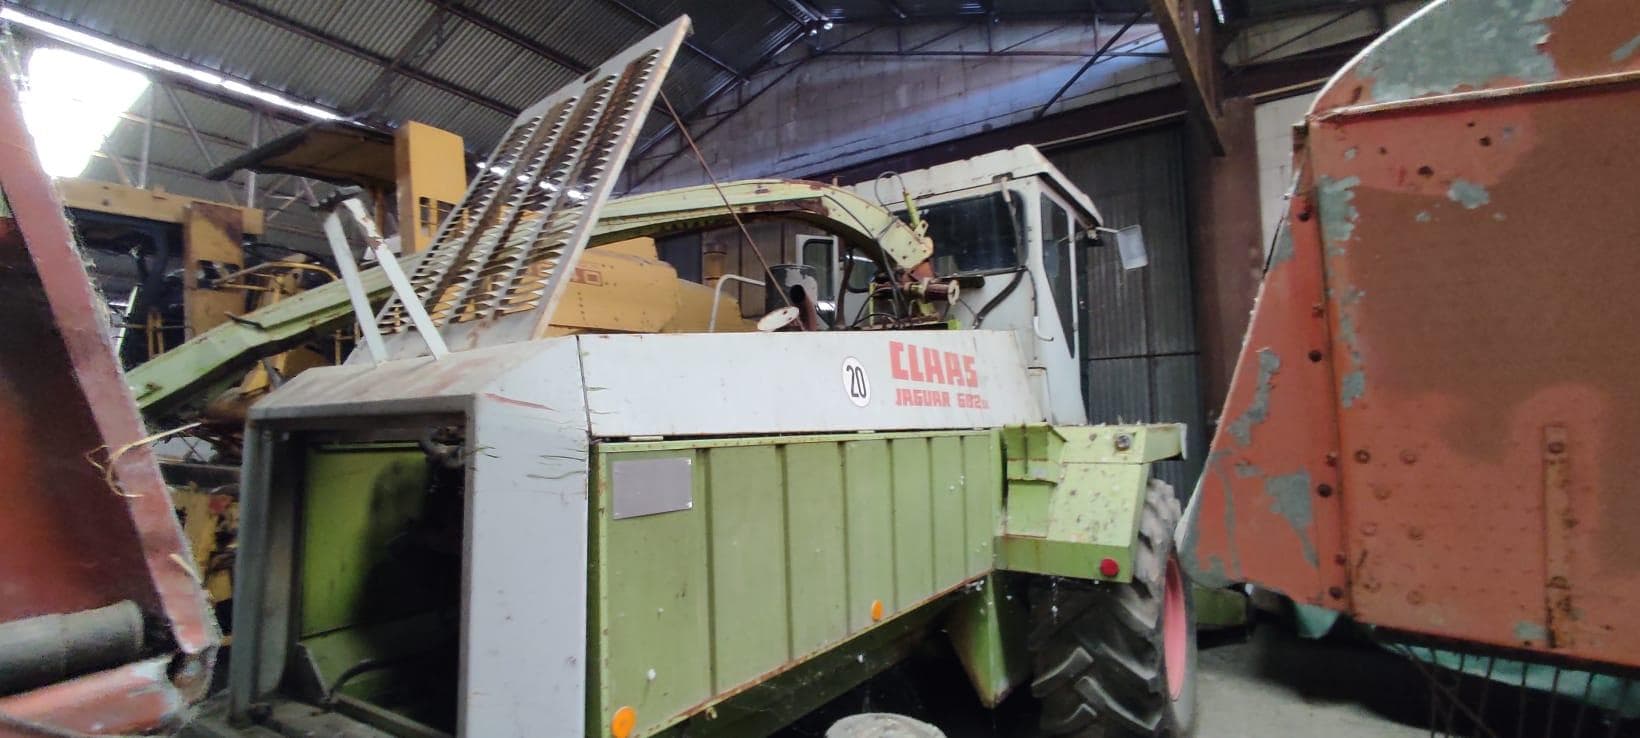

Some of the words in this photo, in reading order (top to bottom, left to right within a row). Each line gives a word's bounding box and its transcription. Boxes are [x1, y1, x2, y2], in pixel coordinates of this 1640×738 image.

[889, 341, 978, 388] CLAAS
[846, 365, 867, 398] 20
[895, 388, 951, 407] JAGUAR
